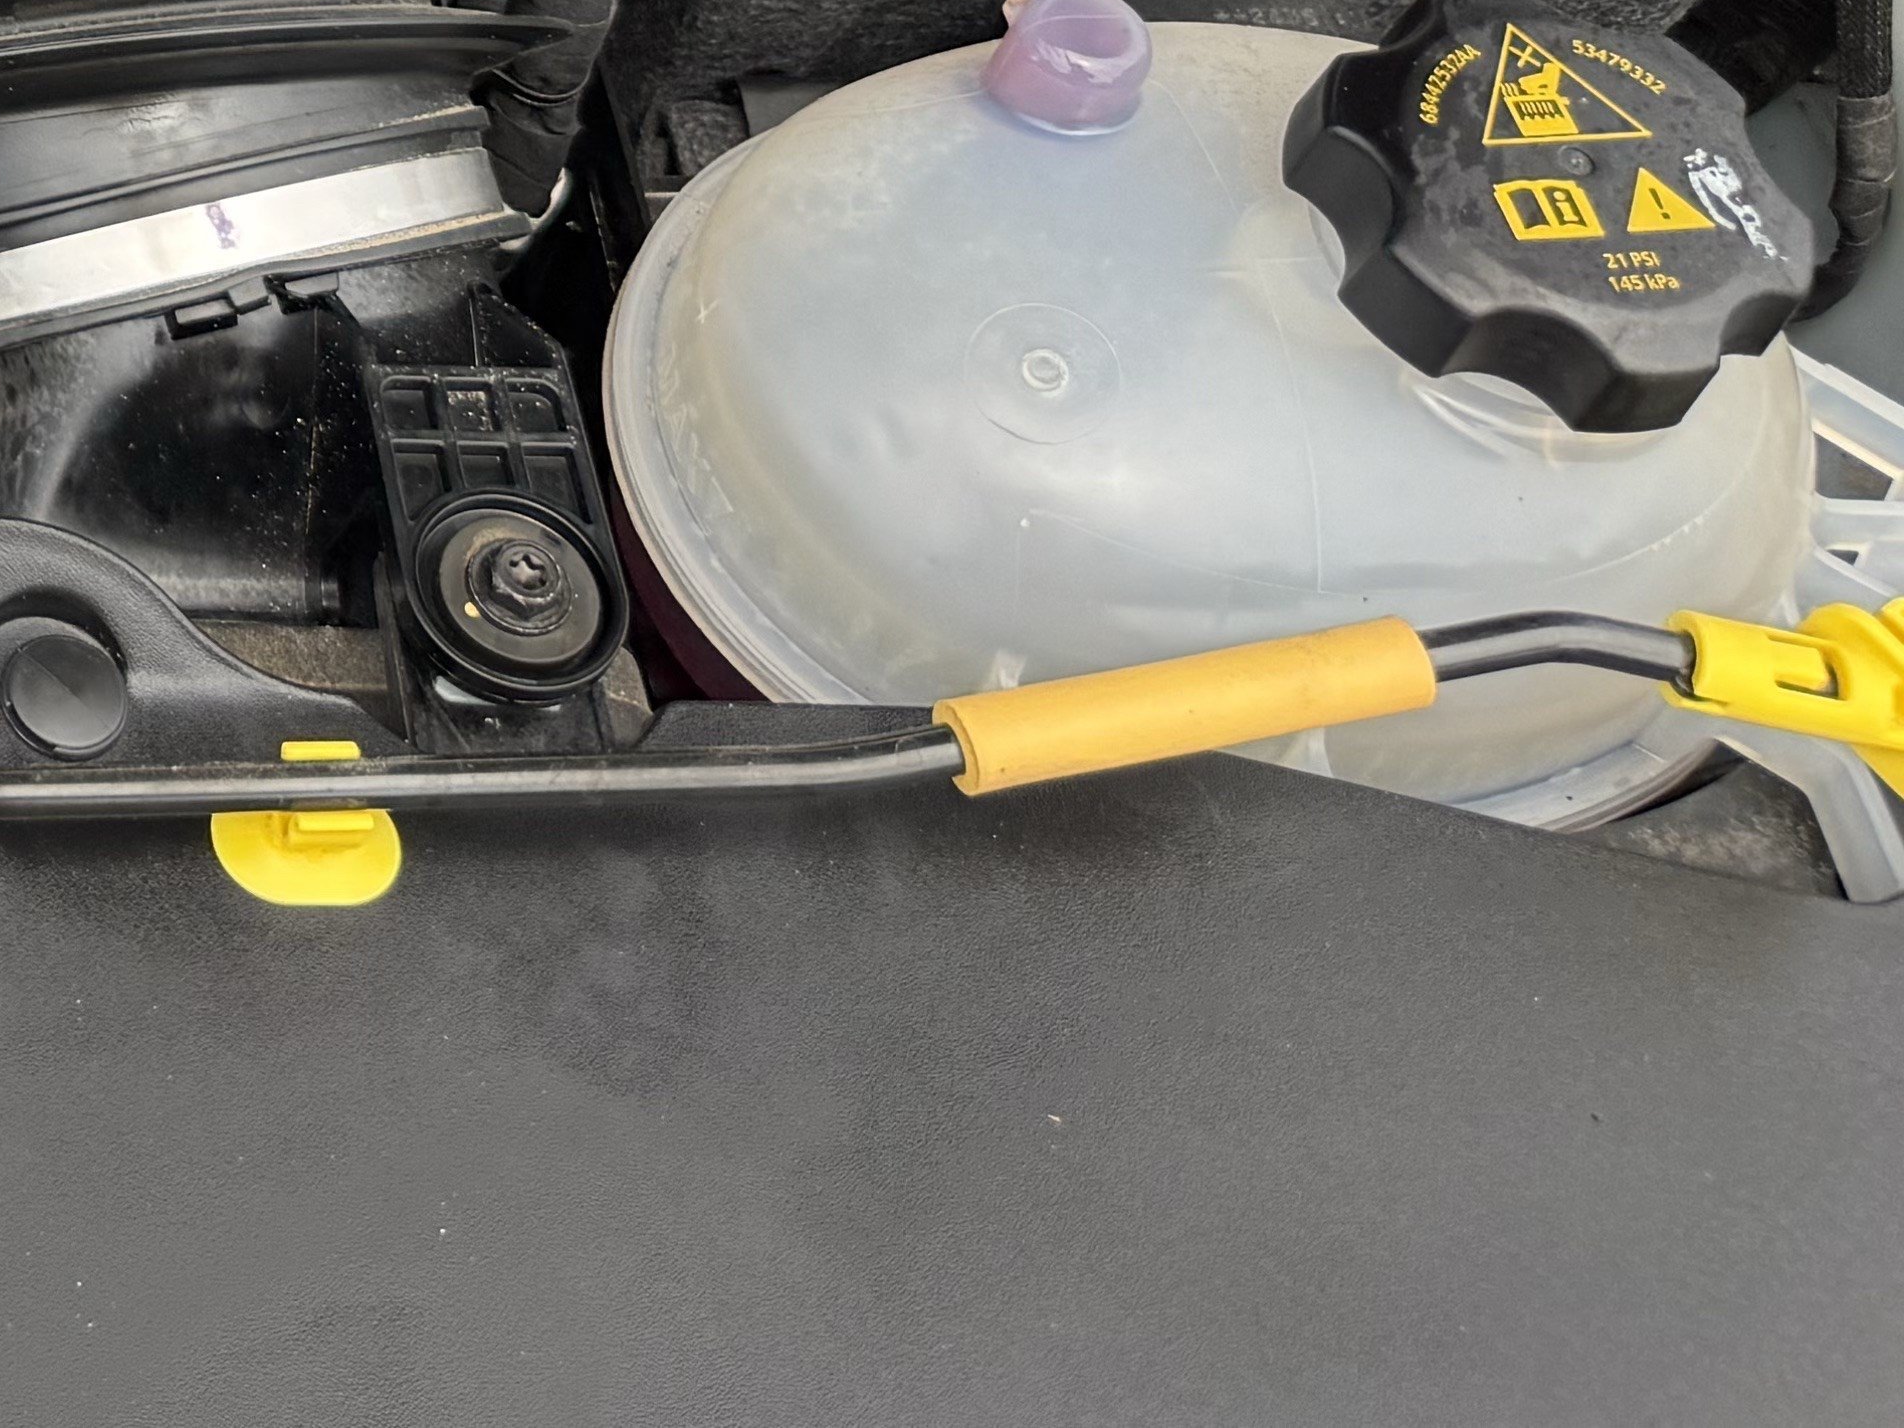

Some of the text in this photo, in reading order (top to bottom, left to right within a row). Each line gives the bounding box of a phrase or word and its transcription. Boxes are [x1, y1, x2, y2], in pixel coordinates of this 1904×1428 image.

[1418, 43, 1482, 127] 68442532AA
[1571, 38, 1669, 96] 53479332
[1602, 250, 1661, 270] 21 PSI
[1608, 270, 1684, 293] 145 kPa
